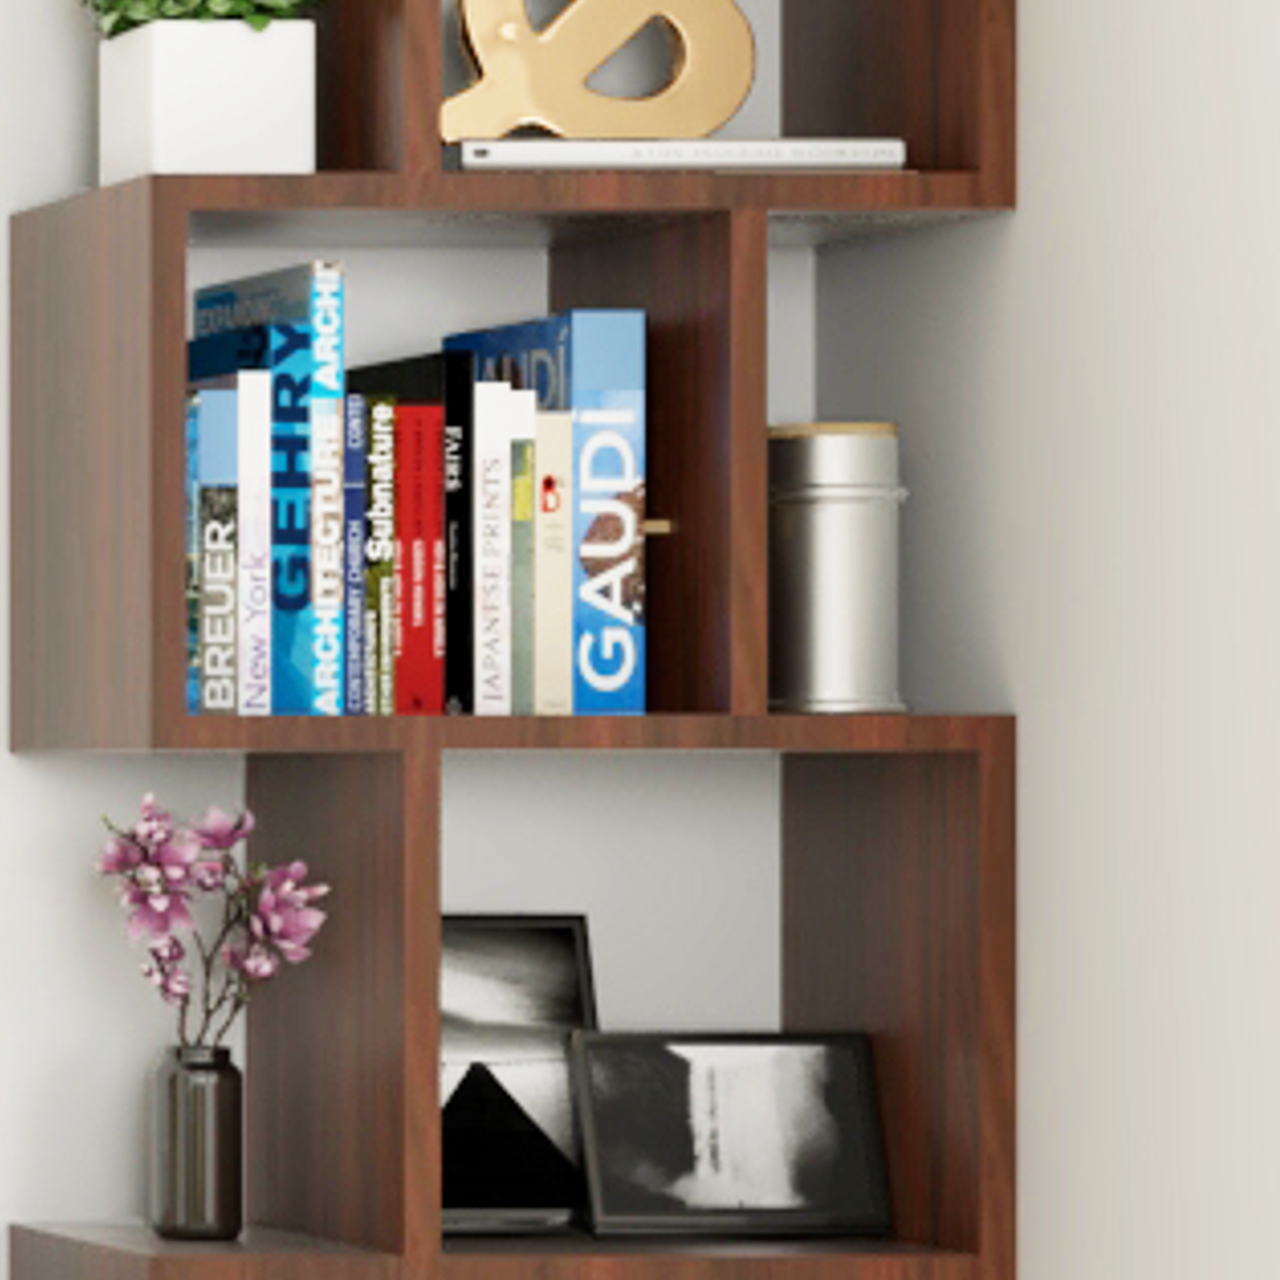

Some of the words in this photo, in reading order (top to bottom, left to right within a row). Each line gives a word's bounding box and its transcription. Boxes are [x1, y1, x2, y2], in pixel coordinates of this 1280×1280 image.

[272, 324, 310, 612] GEHRY
[367, 403, 393, 561] Subnature
[482, 458, 500, 557] PRINTS
[204, 520, 235, 709] BREUER
[243, 553, 267, 623] York
[312, 415, 339, 716] ARCHITECTURE
[482, 564, 503, 701] JAPANESE
[244, 635, 267, 709] New
